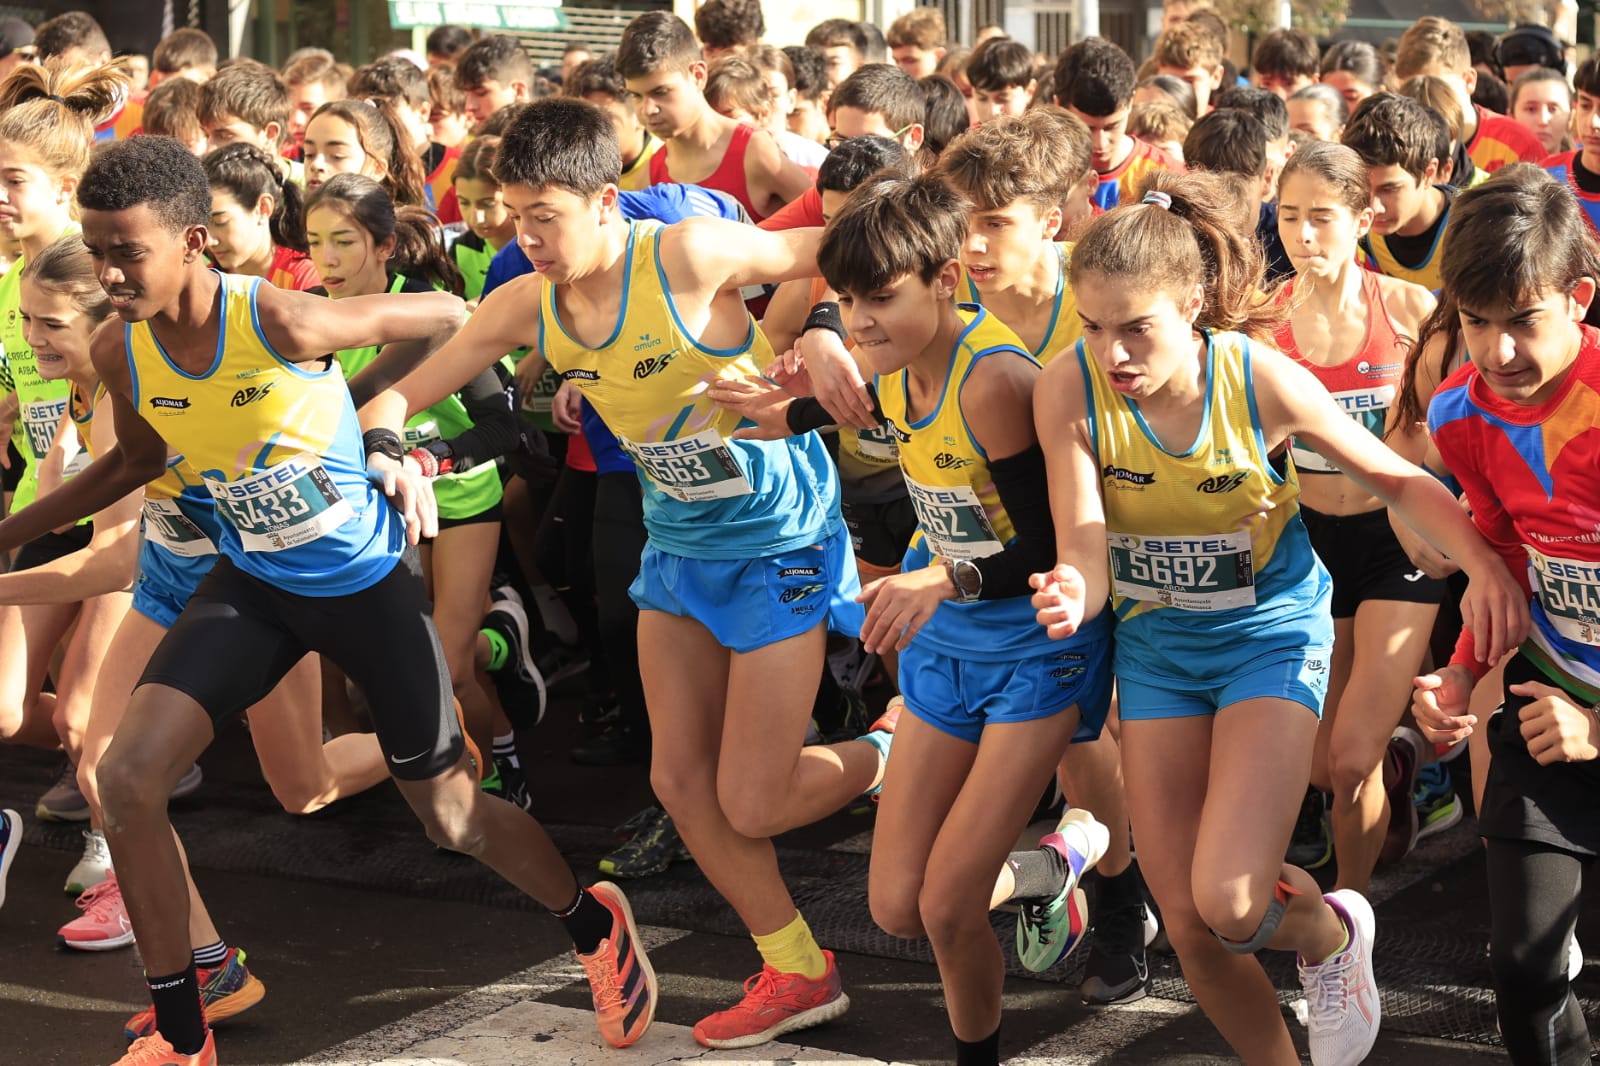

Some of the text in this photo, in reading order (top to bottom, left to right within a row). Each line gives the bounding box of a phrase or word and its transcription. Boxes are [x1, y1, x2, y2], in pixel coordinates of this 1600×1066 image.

[634, 338, 662, 352] amura
[1334, 394, 1384, 410] TEL
[639, 438, 711, 457] SETEL
[228, 463, 307, 498] SETEL
[226, 484, 310, 529] 5433
[1143, 539, 1237, 554] SETEL
[1129, 551, 1219, 587] 5692
[1541, 574, 1600, 614] 544
